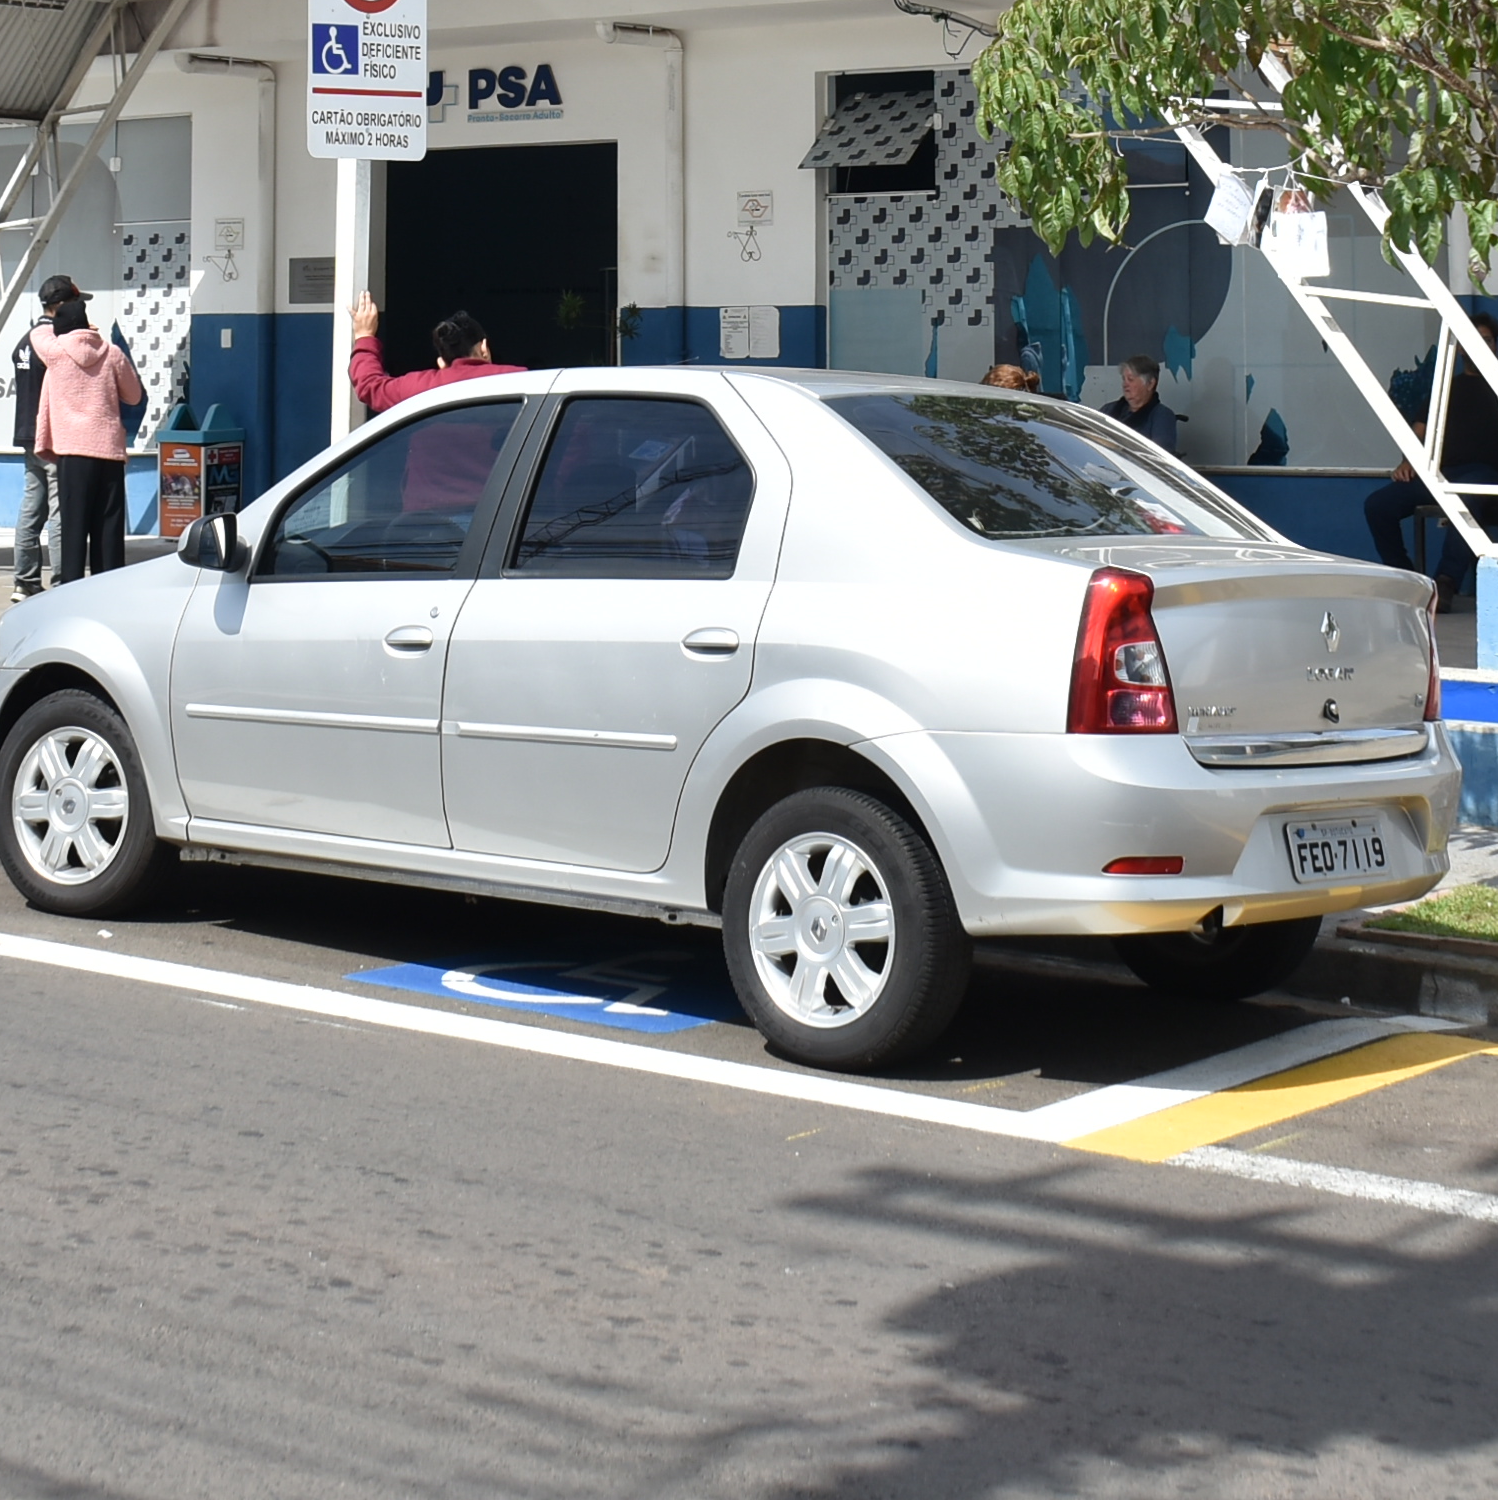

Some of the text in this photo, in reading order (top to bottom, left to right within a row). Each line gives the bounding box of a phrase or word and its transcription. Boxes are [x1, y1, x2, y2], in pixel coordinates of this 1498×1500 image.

[362, 21, 421, 39] EXCLUSIVO
[362, 42, 421, 60] DEFICIENTE
[363, 61, 397, 79] FÍSICO
[469, 64, 563, 109] PSA
[312, 109, 421, 128] CARTÃO OBRIGATÓRIO
[325, 128, 409, 148] MÁXIMO 2 HORAS
[1307, 666, 1354, 681] LOGAN
